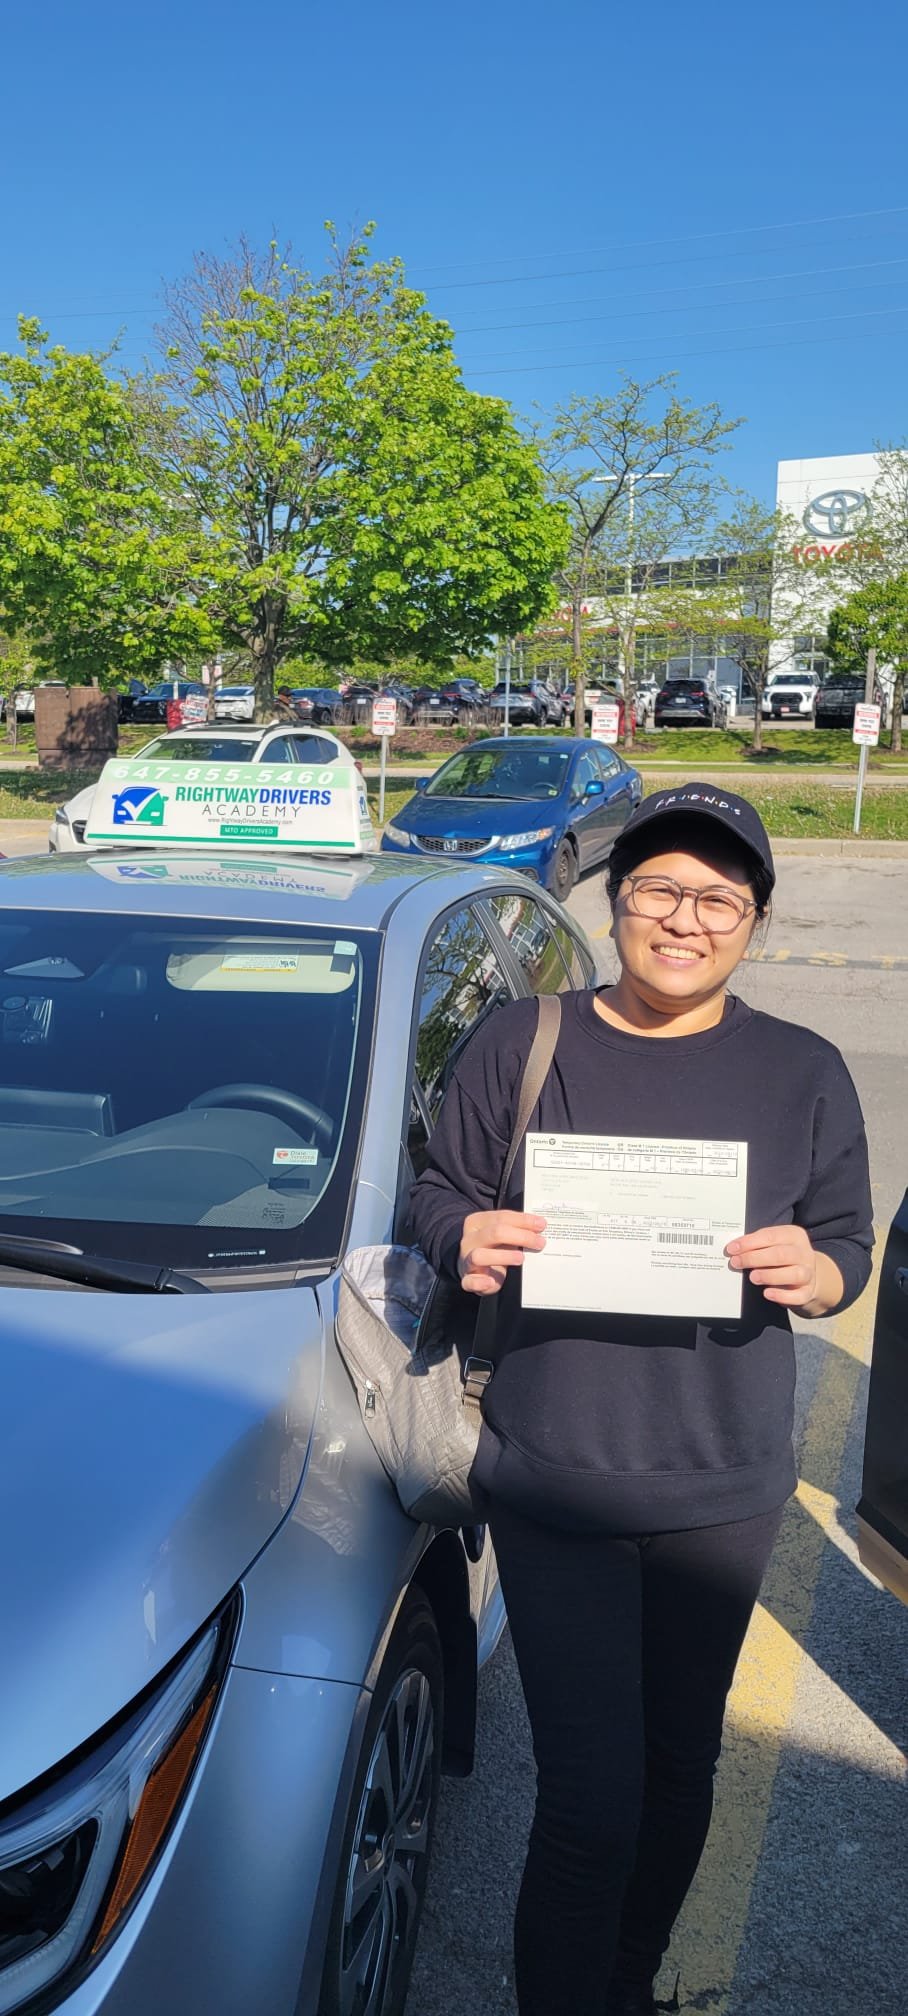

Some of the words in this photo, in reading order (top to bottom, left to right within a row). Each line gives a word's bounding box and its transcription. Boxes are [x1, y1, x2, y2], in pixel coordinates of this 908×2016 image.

[113, 765, 335, 785] 647-855-5460
[175, 786, 332, 805] RIGHTWAYDRIVERS
[202, 804, 301, 818] ACADEMY
[240, 827, 273, 835] APPROVED
